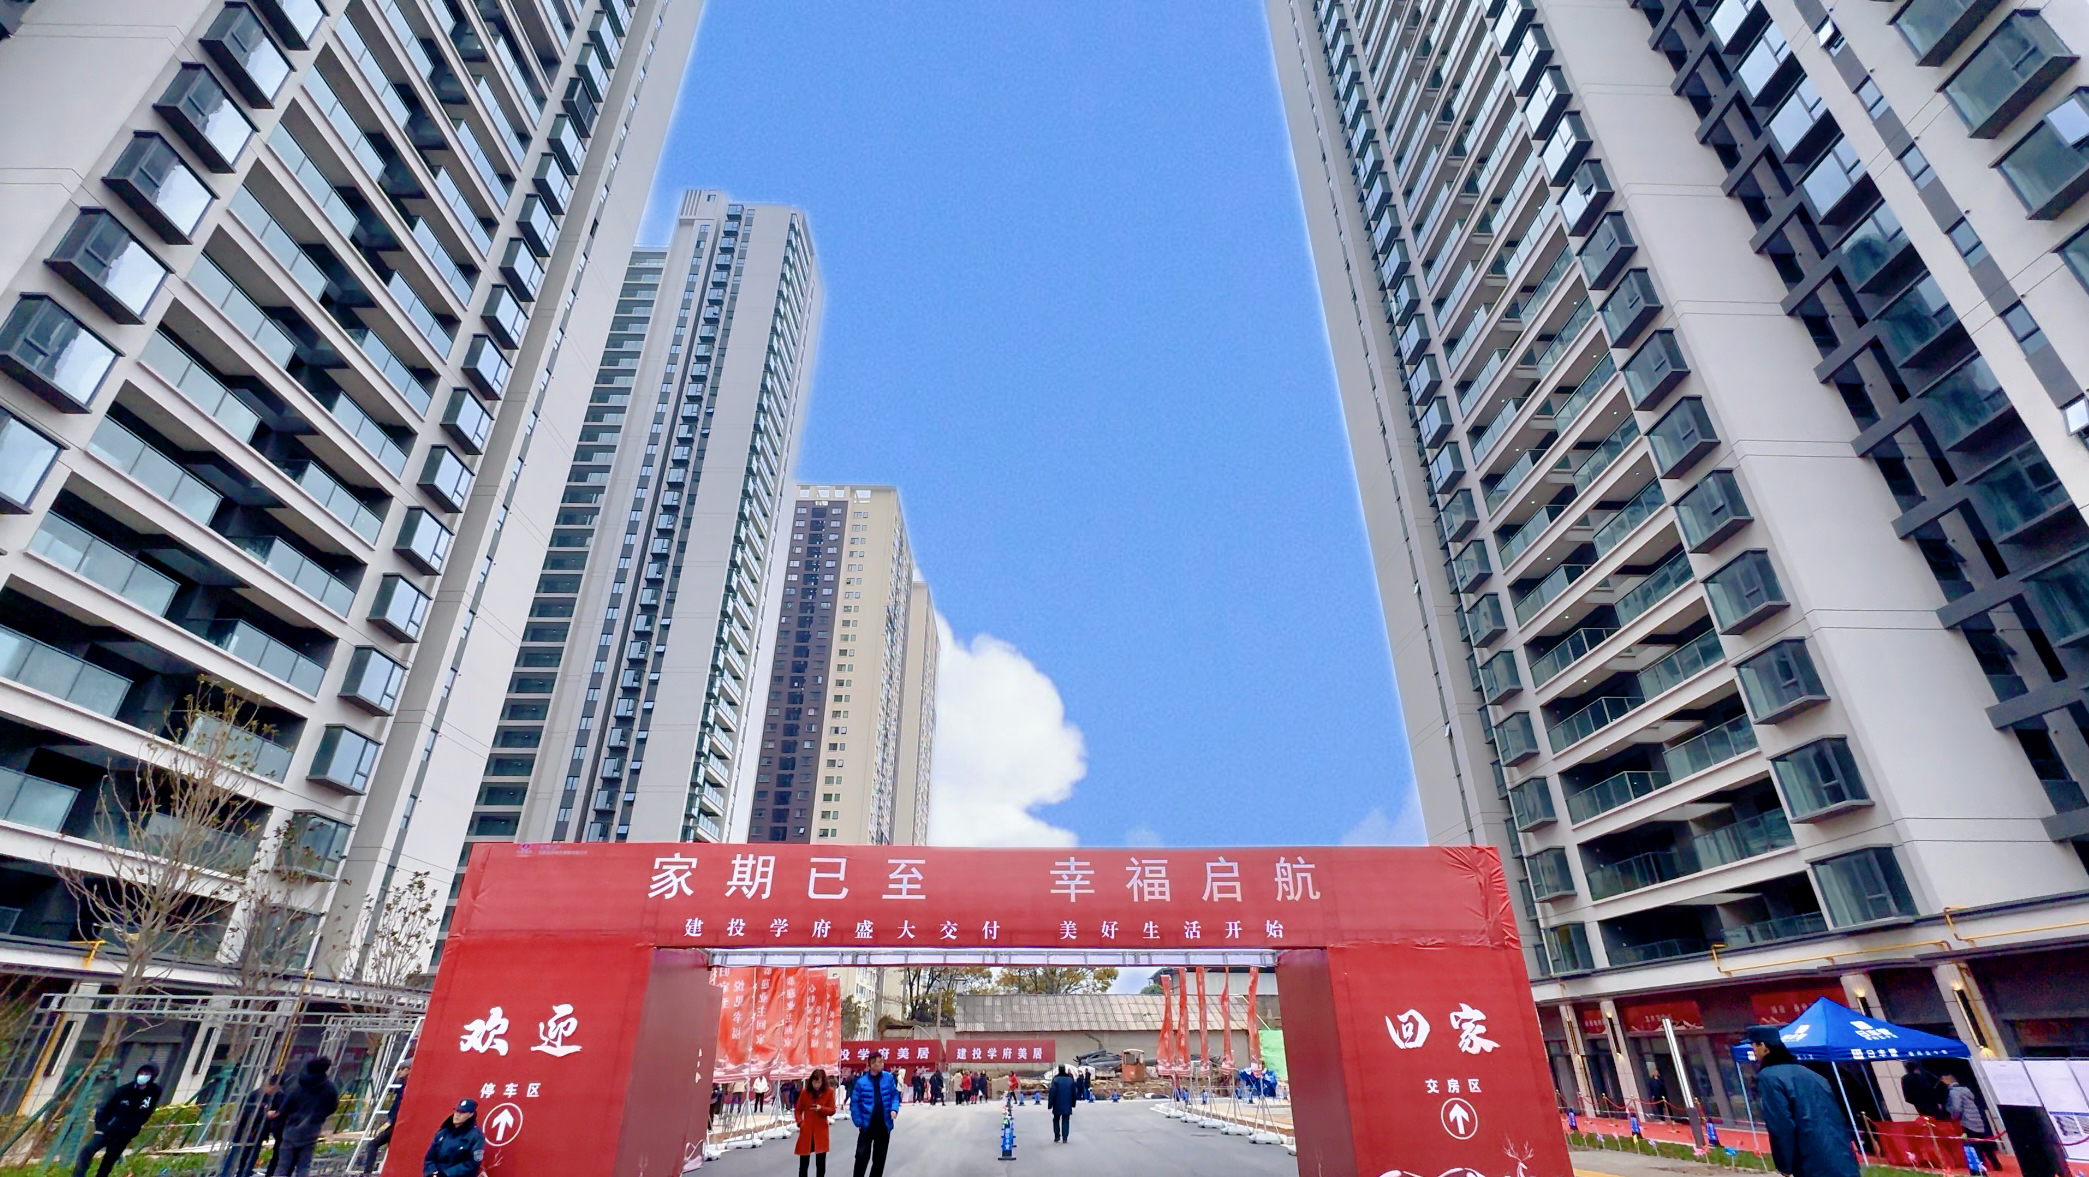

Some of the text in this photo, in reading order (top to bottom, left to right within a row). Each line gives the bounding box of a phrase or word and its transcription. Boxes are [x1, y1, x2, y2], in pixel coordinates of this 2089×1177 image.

[648, 853, 1321, 902] 家期已至 幸福启航
[684, 917, 1284, 940] 建投学府盛大交付 美好生活开始
[460, 1003, 583, 1057] 欢迎
[1385, 1002, 1500, 1055] 回家
[956, 1047, 1043, 1060] 建投学府美居
[480, 1082, 541, 1099] 停车区
[1425, 1078, 1482, 1094] 交房区
